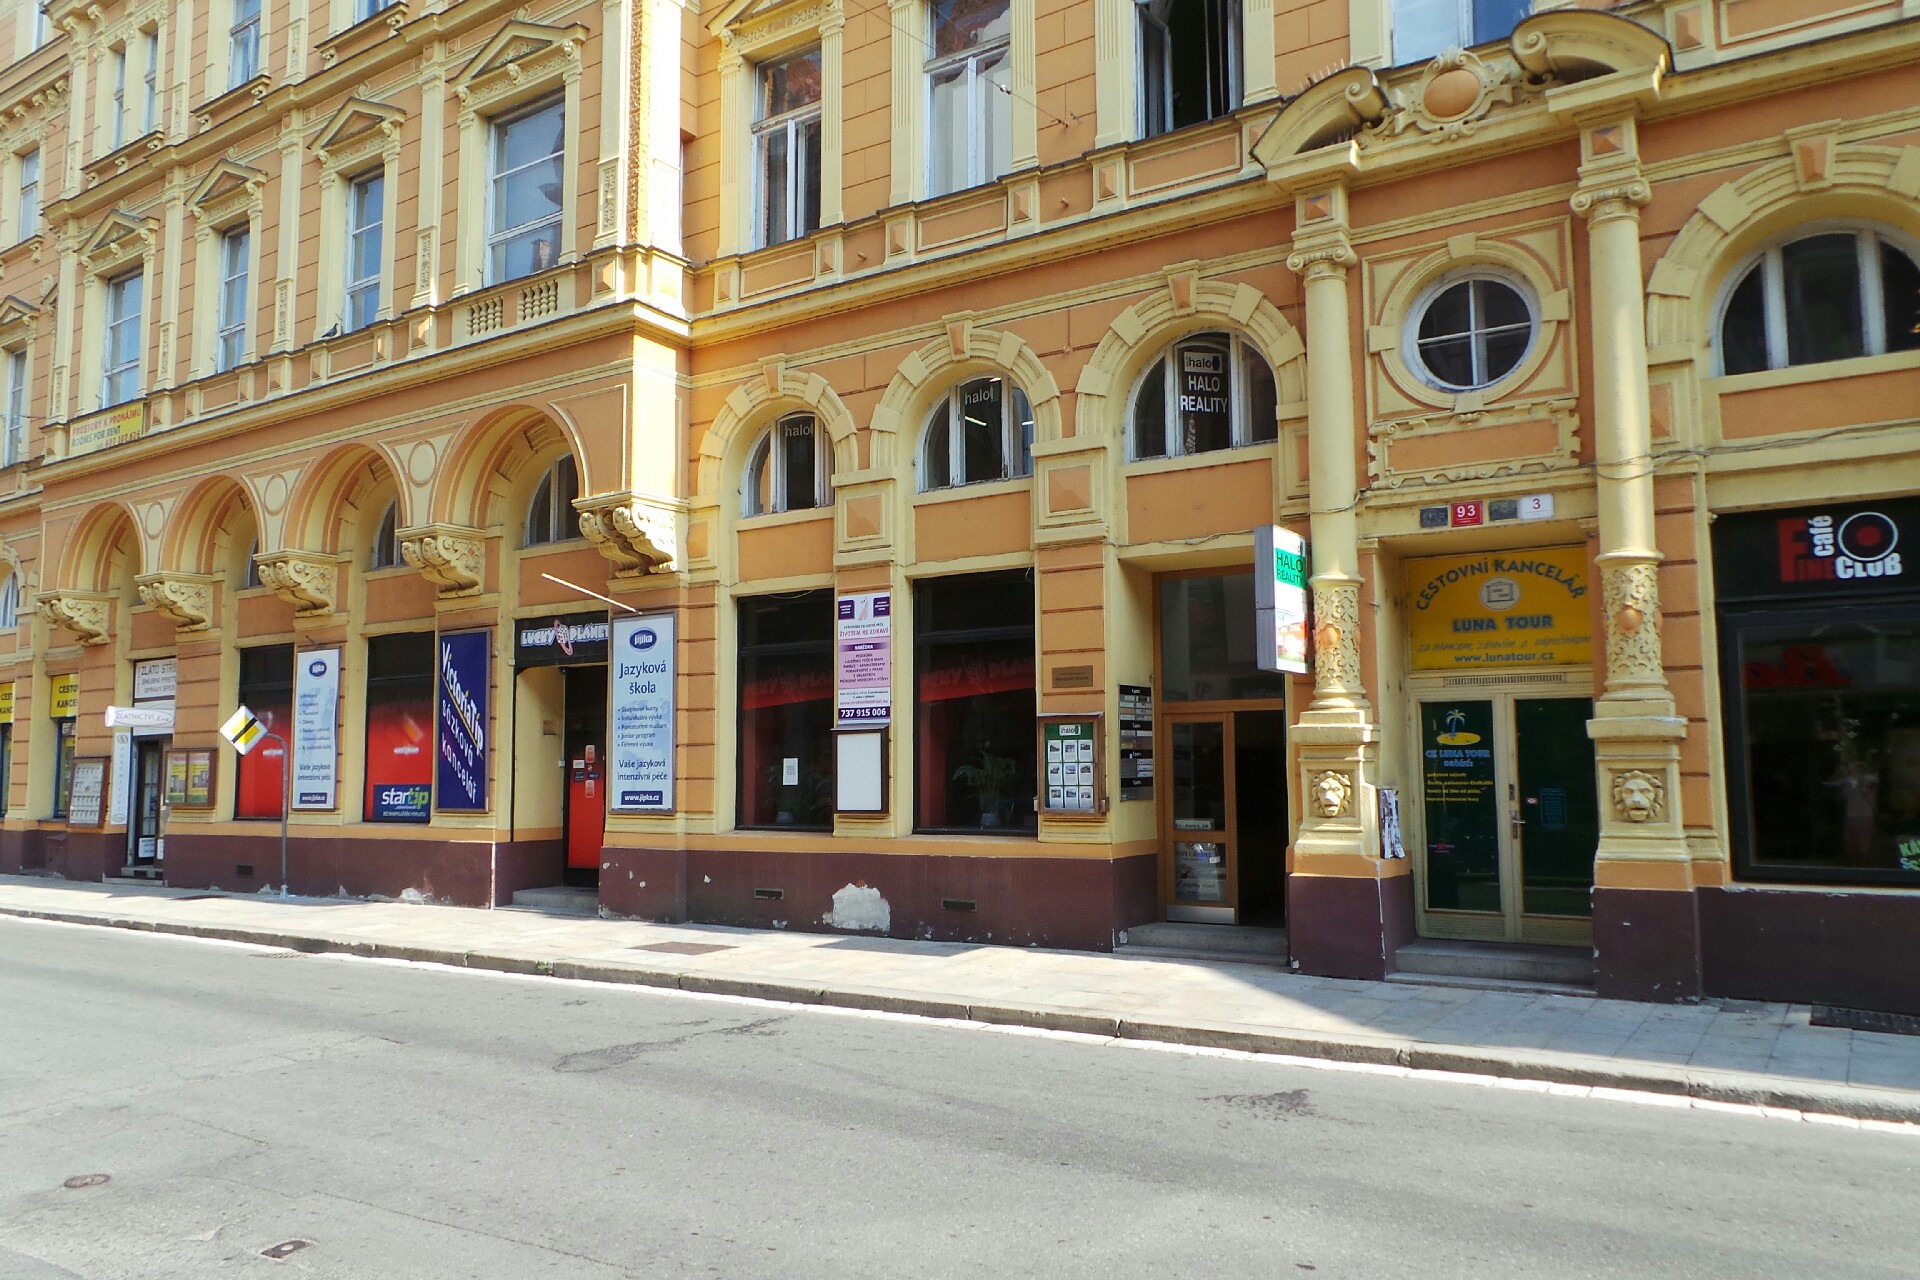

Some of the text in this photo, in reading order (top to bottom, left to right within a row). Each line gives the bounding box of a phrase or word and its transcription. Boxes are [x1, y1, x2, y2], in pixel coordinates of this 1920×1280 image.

[1188, 356, 1212, 368] halo
[1188, 375, 1220, 392] HALO
[1180, 395, 1227, 413] REALITY
[1457, 504, 1475, 517] 93
[1532, 498, 1540, 509] 3
[1808, 515, 1834, 556] café
[1276, 551, 1303, 573] HALO
[1835, 552, 1902, 579] CLUB
[1276, 568, 1304, 585] REALITY
[1416, 557, 1588, 610] CESTOVNÍ KANCELÁŘ
[1453, 615, 1553, 632] LUNA TOUR
[521, 628, 556, 646] LUCKY
[1454, 652, 1554, 663] www.lunatour.cz
[141, 665, 159, 675] ZLATO
[619, 660, 666, 679] Jazyková
[630, 681, 656, 694] škola
[856, 709, 870, 717] 915
[872, 708, 886, 716] 006
[442, 732, 476, 804] kancelář
[619, 759, 666, 770] Vaše jazyková
[652, 772, 667, 782] péče
[381, 787, 429, 809] startip
